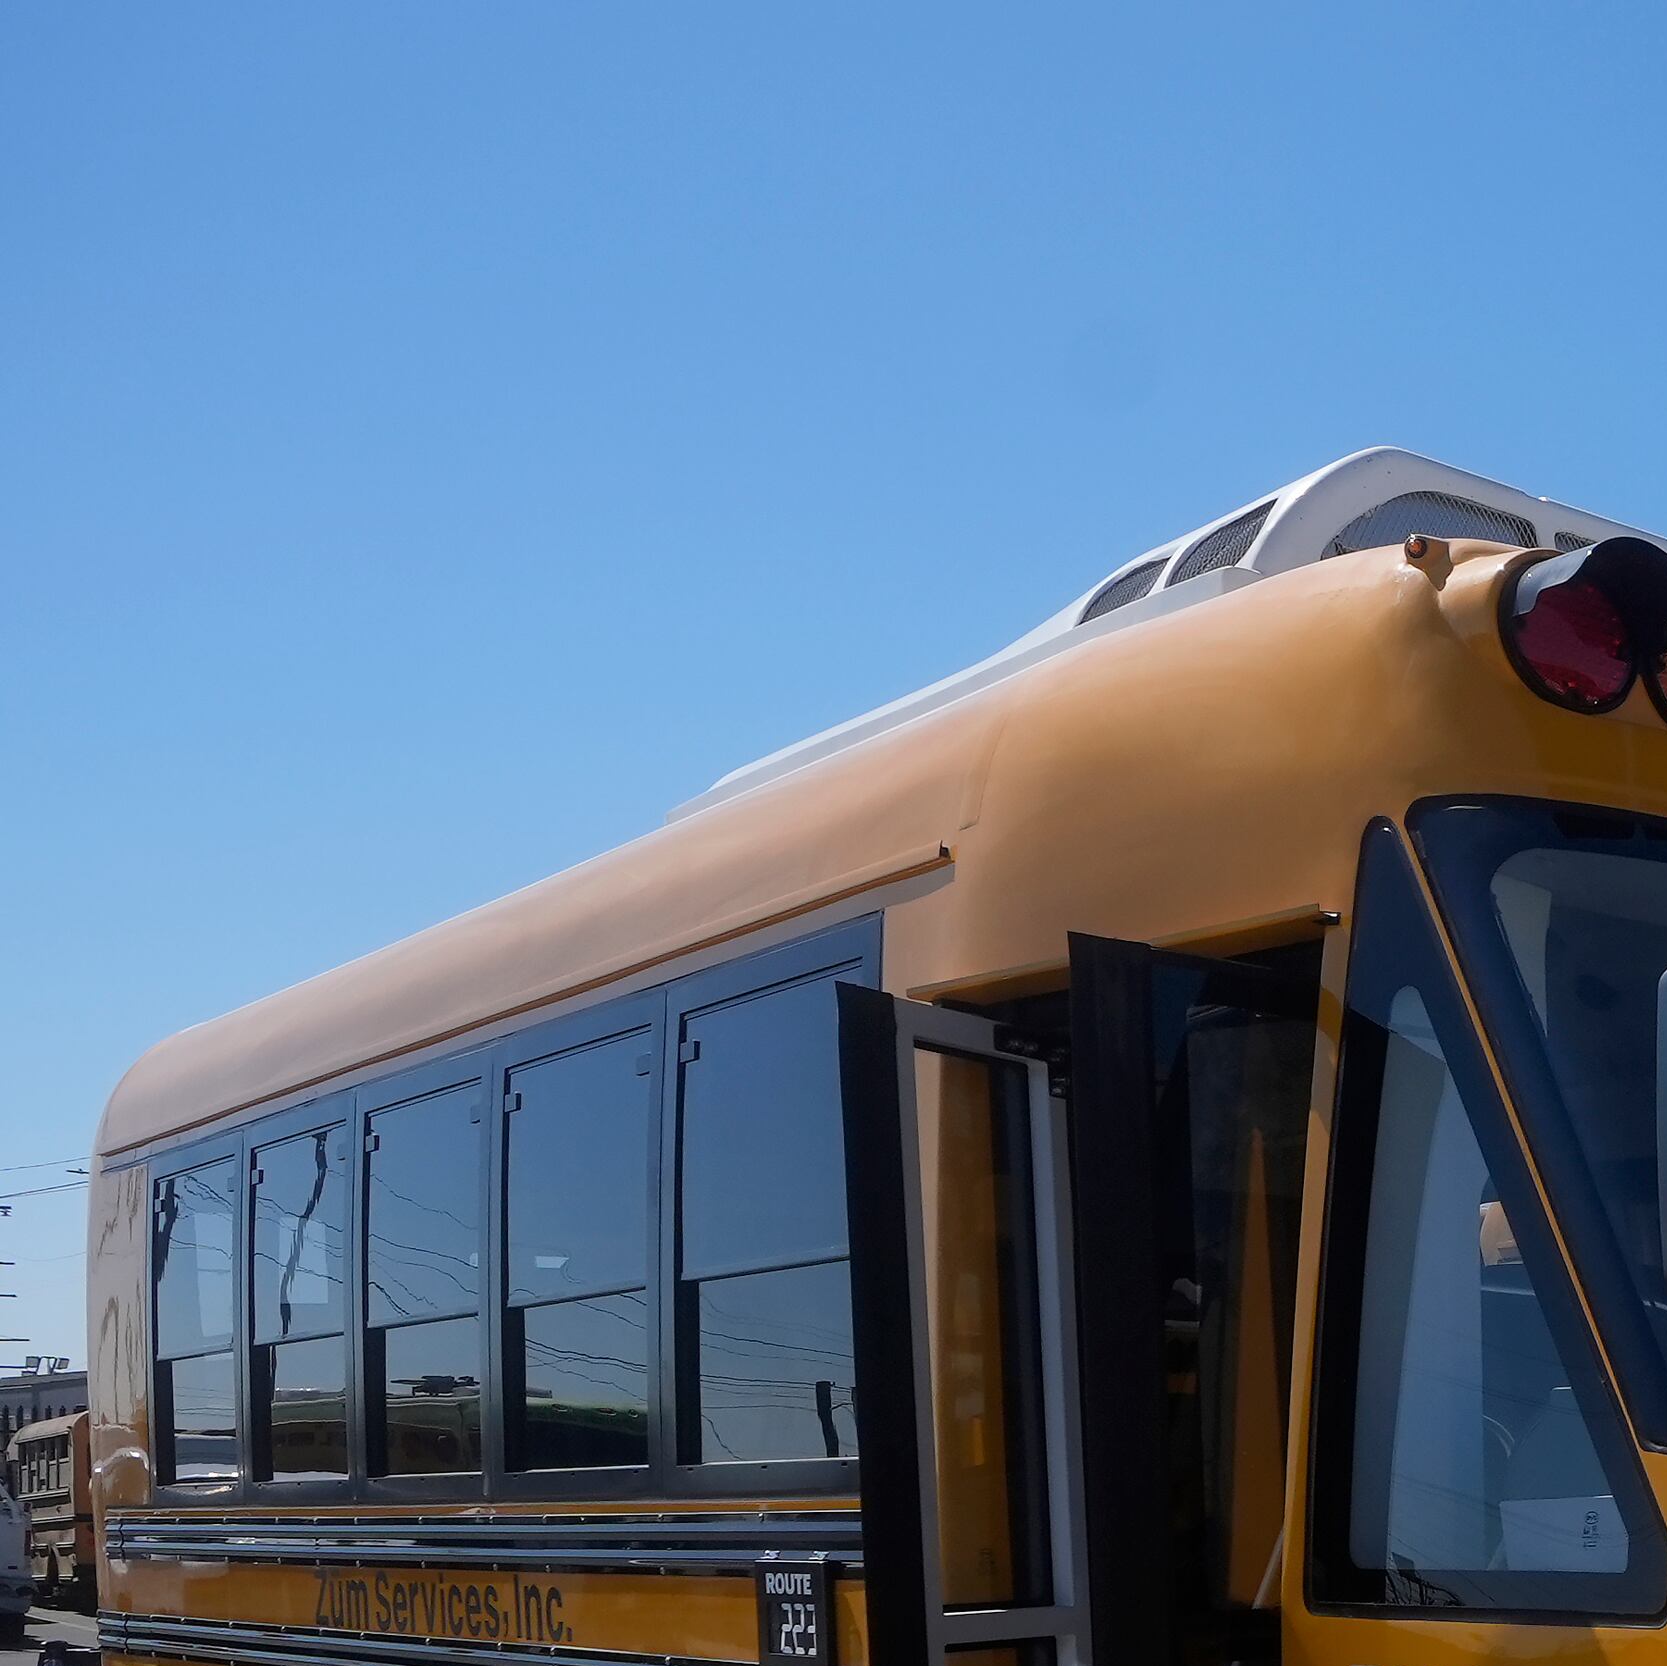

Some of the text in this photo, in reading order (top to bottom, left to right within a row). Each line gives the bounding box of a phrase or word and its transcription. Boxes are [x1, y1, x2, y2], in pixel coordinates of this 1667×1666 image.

[375, 1569, 509, 1639] Services,
[513, 1573, 573, 1643] Inc.
[764, 1572, 813, 1596] ROUTE
[780, 1602, 817, 1656] 223
